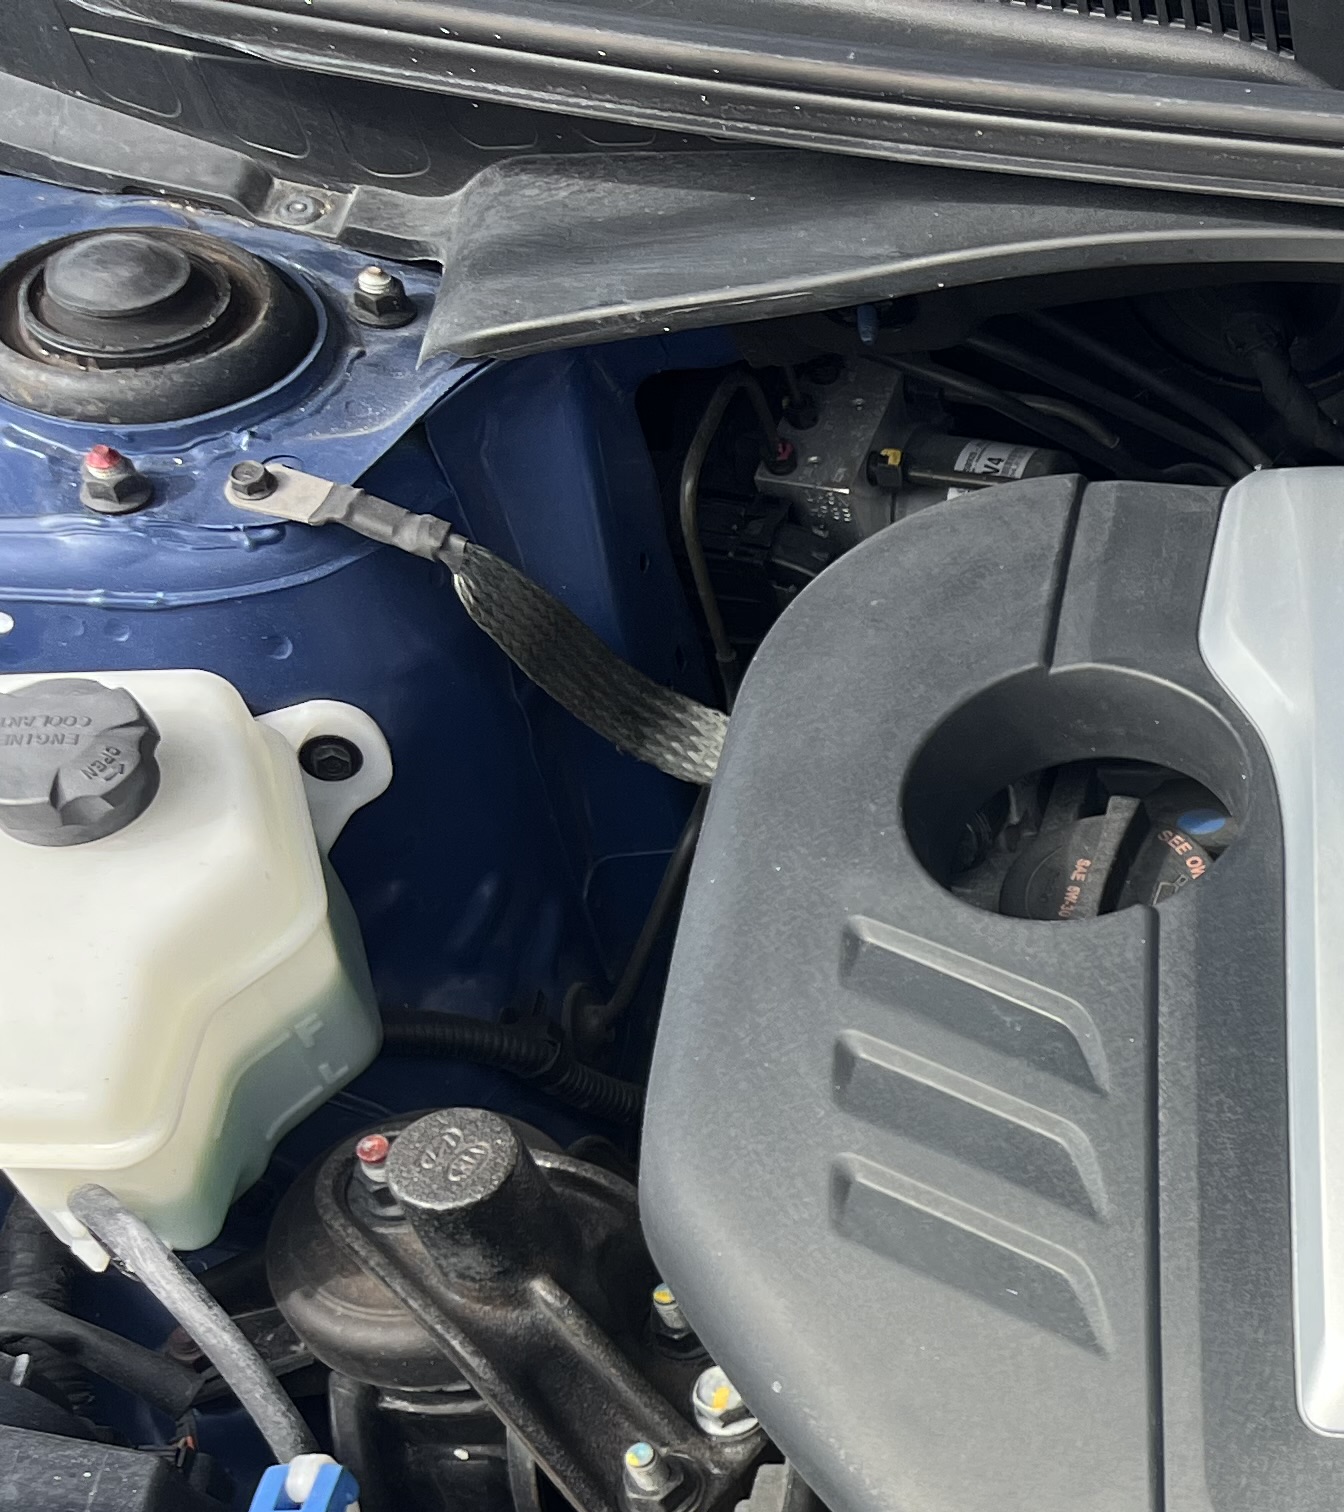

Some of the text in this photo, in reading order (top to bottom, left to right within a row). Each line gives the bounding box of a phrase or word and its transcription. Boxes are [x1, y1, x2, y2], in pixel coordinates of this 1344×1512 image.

[982, 457, 1004, 475] V4
[79, 745, 122, 781] OPEN
[1157, 829, 1193, 856] SEE
[1070, 858, 1091, 882] SAE
